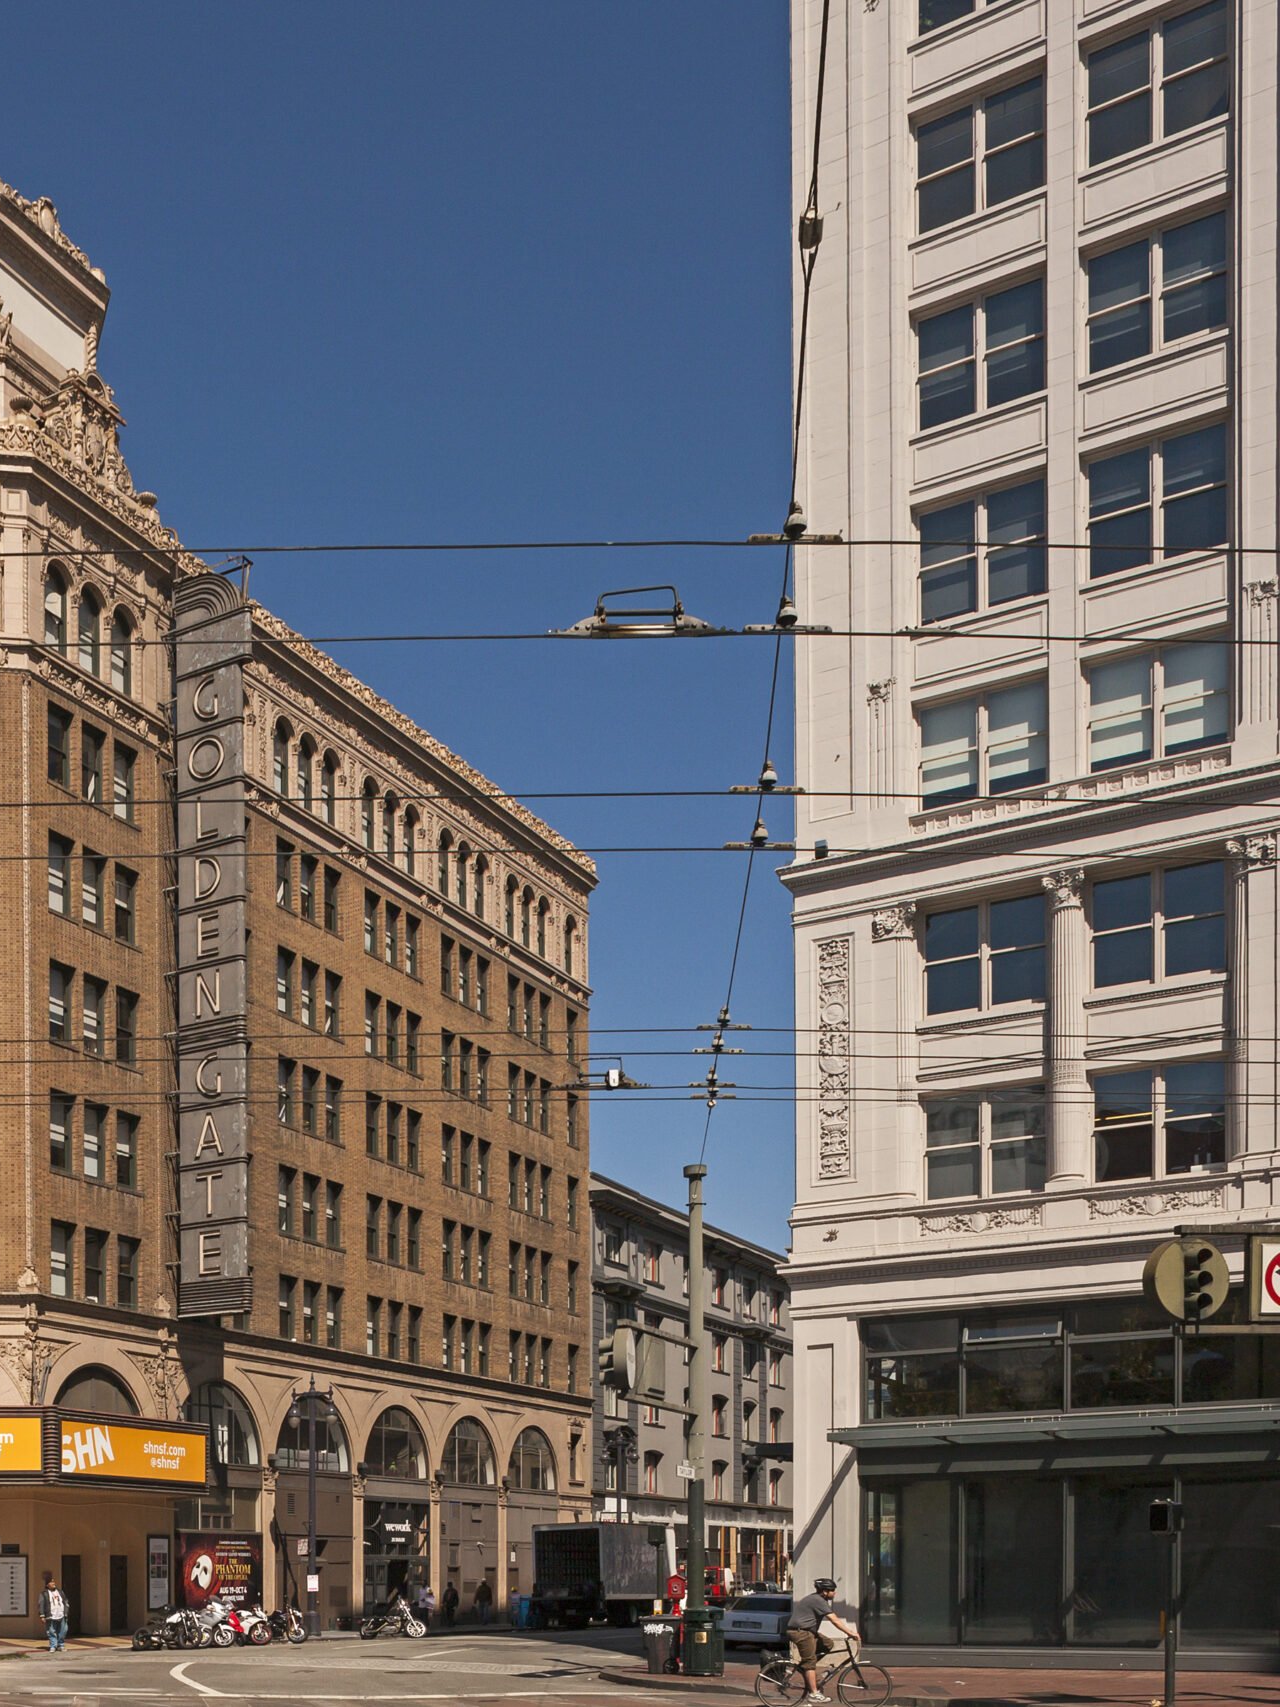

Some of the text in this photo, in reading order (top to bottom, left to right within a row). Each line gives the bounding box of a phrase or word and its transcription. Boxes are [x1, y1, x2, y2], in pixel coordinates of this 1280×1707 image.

[187, 675, 224, 1276] GOLDEN GATE
[62, 1425, 115, 1473] SHN
[144, 1441, 186, 1457] shnsf.com
[150, 1456, 180, 1470] @shnsf
[215, 1564, 251, 1574] PHANTOM
[219, 1586, 229, 1594] AUG
